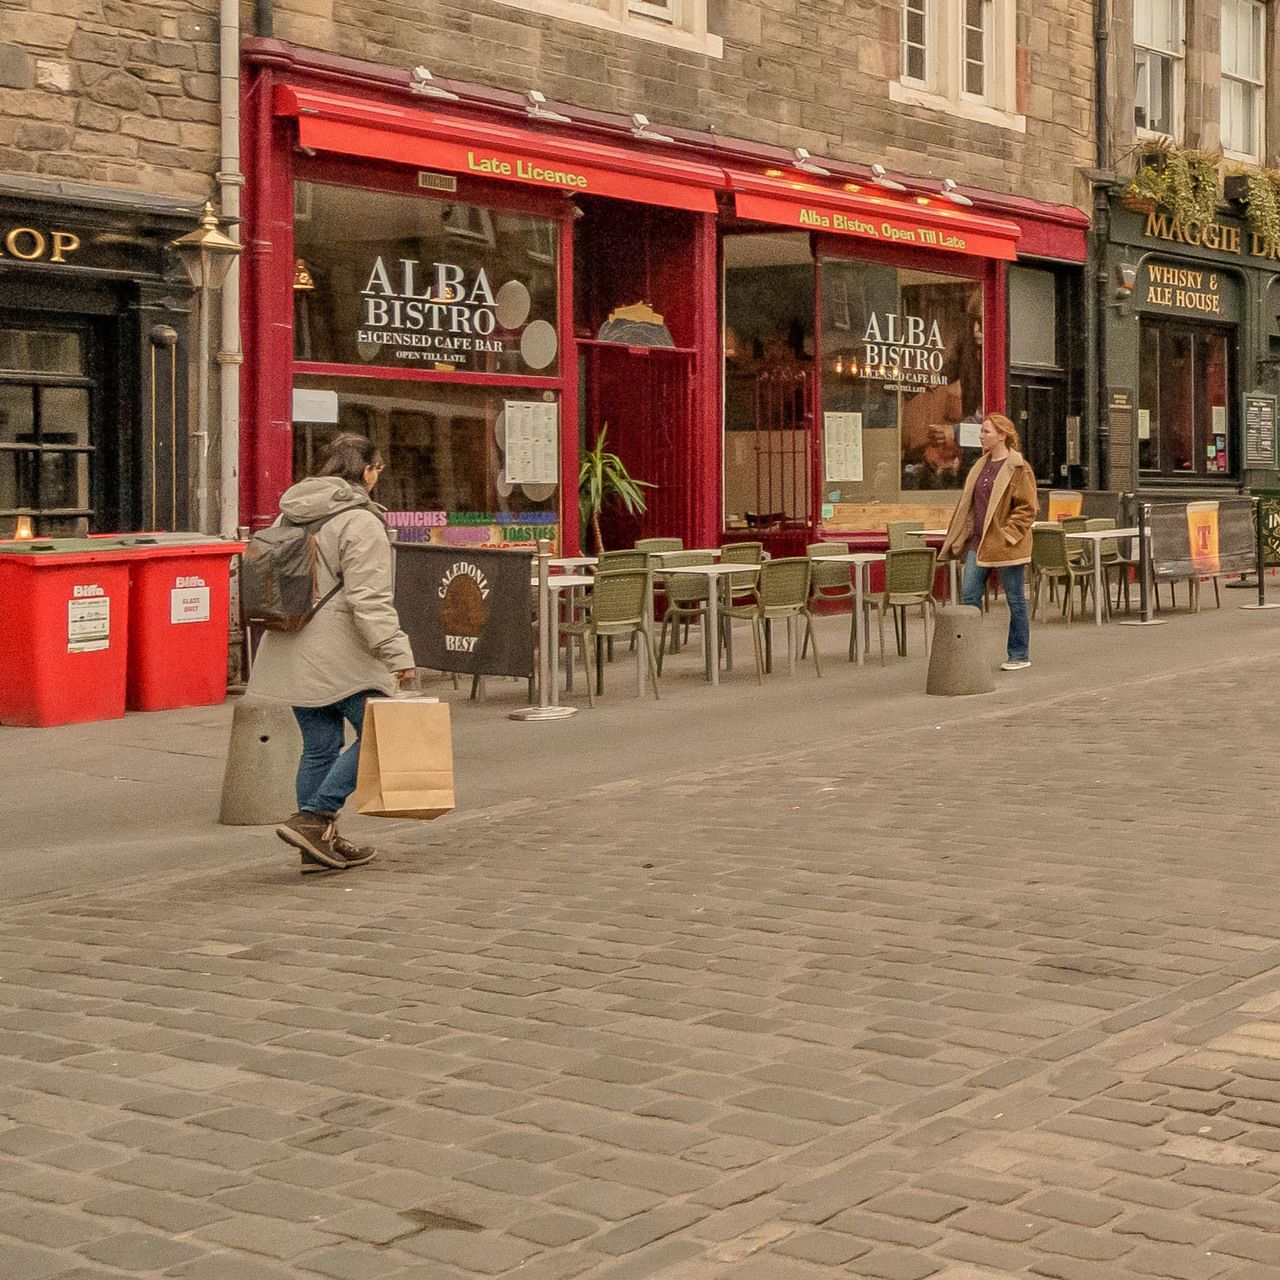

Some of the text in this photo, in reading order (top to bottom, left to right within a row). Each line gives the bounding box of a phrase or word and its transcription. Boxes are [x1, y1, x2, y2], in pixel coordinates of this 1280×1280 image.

[468, 152, 588, 188] Late Licence
[800, 208, 966, 249] Alba Bistro, Open Till Late
[361, 256, 499, 306] ALBA
[1148, 265, 1218, 291] WHISKY &
[1147, 286, 1219, 313] ALE HOUSE
[364, 297, 496, 336] BISTRO
[862, 311, 946, 350] ALBA
[357, 330, 503, 353] LICENSED CAFE BAR
[396, 351, 421, 360] OPEN
[864, 343, 944, 372] BISTRO
[906, 372, 929, 384] CAFE
[384, 511, 448, 527] DWICHES
[438, 561, 490, 600] CALEDONIA
[445, 634, 478, 653] BEST
